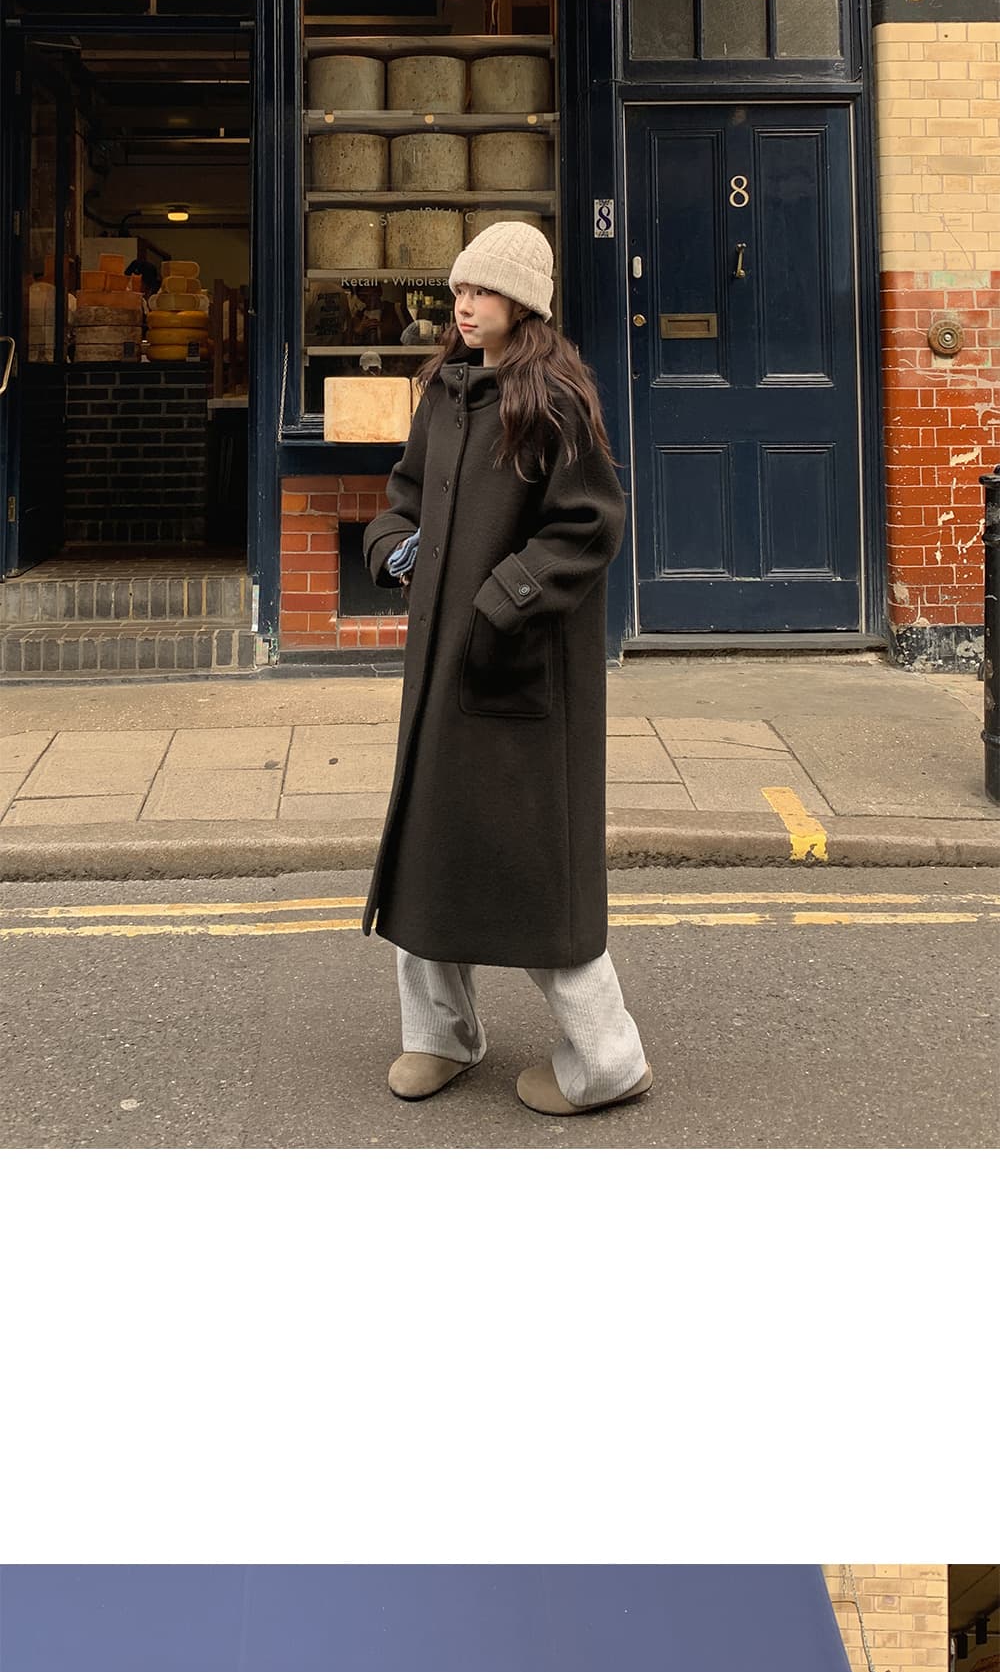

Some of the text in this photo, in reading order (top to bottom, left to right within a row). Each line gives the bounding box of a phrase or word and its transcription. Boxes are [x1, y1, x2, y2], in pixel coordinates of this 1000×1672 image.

[729, 175, 750, 208] 8
[596, 205, 612, 232] 8
[341, 276, 450, 287] Retail Wholesa
